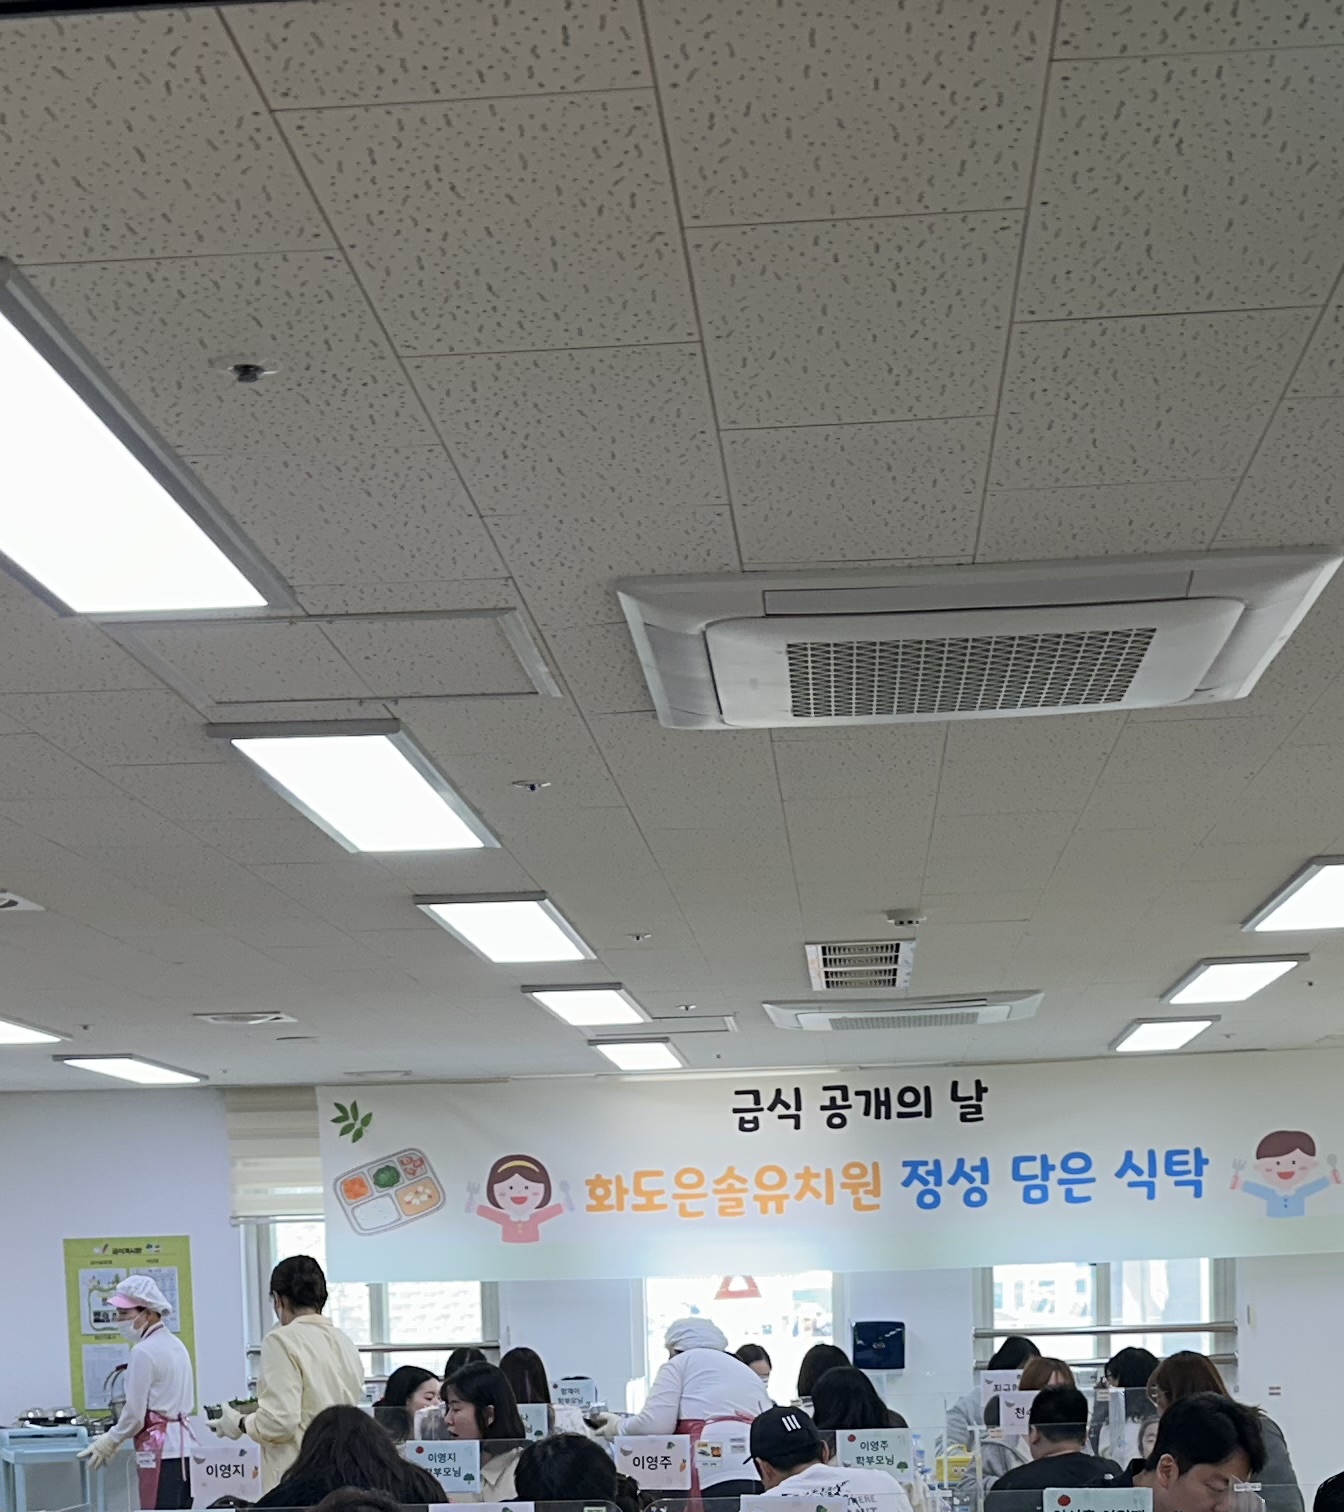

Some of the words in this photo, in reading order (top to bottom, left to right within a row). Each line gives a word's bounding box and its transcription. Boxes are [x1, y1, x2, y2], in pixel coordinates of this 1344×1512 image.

[732, 1086, 803, 1132] 급식
[819, 1084, 933, 1129] 공개의
[949, 1078, 989, 1123] 날
[584, 1160, 882, 1218] 화도은솔유치원
[900, 1155, 992, 1211] 정성
[1011, 1150, 1097, 1204] 담은
[1113, 1146, 1210, 1201] 식탁
[859, 1440, 889, 1452] 이영주
[427, 1452, 457, 1464] 이영지
[632, 1455, 673, 1470] 이영주
[855, 1454, 895, 1467] 학부모님
[205, 1463, 245, 1479] 이영지
